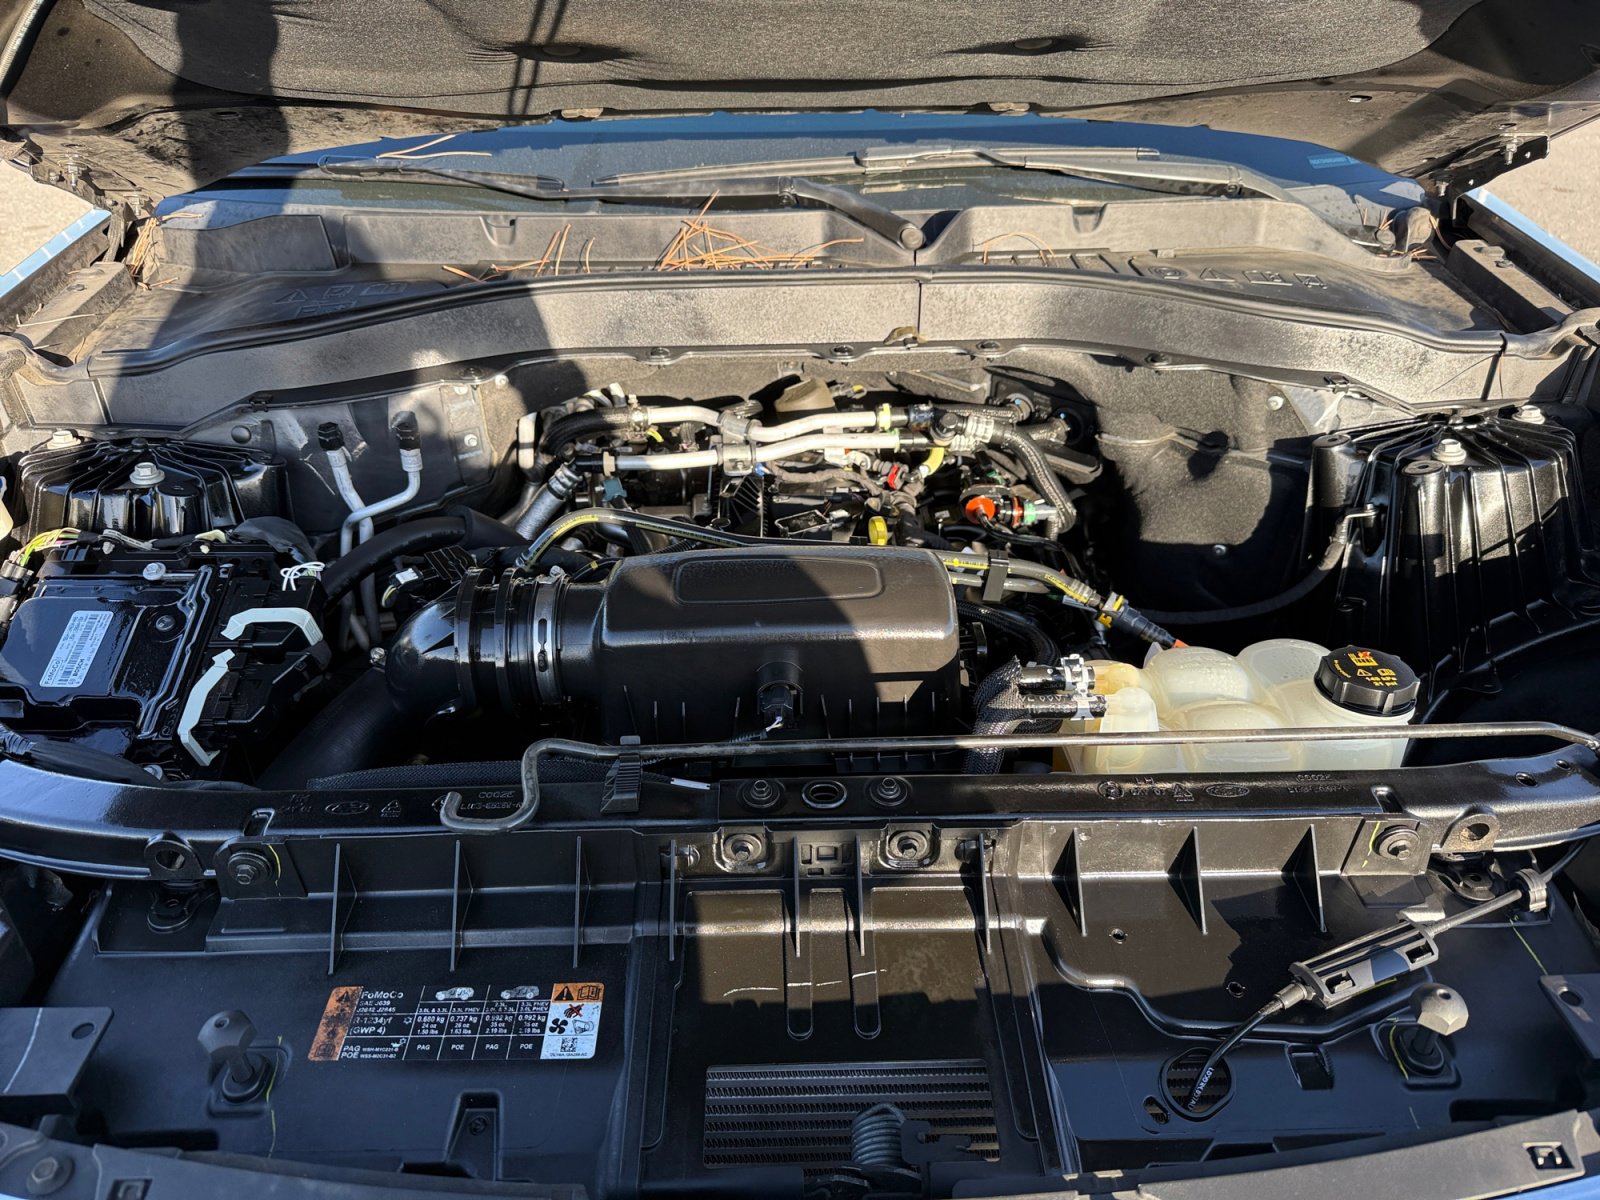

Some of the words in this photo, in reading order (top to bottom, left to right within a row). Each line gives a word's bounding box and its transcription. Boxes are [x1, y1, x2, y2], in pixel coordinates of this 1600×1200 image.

[361, 991, 404, 999] FoMoCo
[350, 1026, 376, 1035] (GWP
[377, 1026, 386, 1035] 4)
